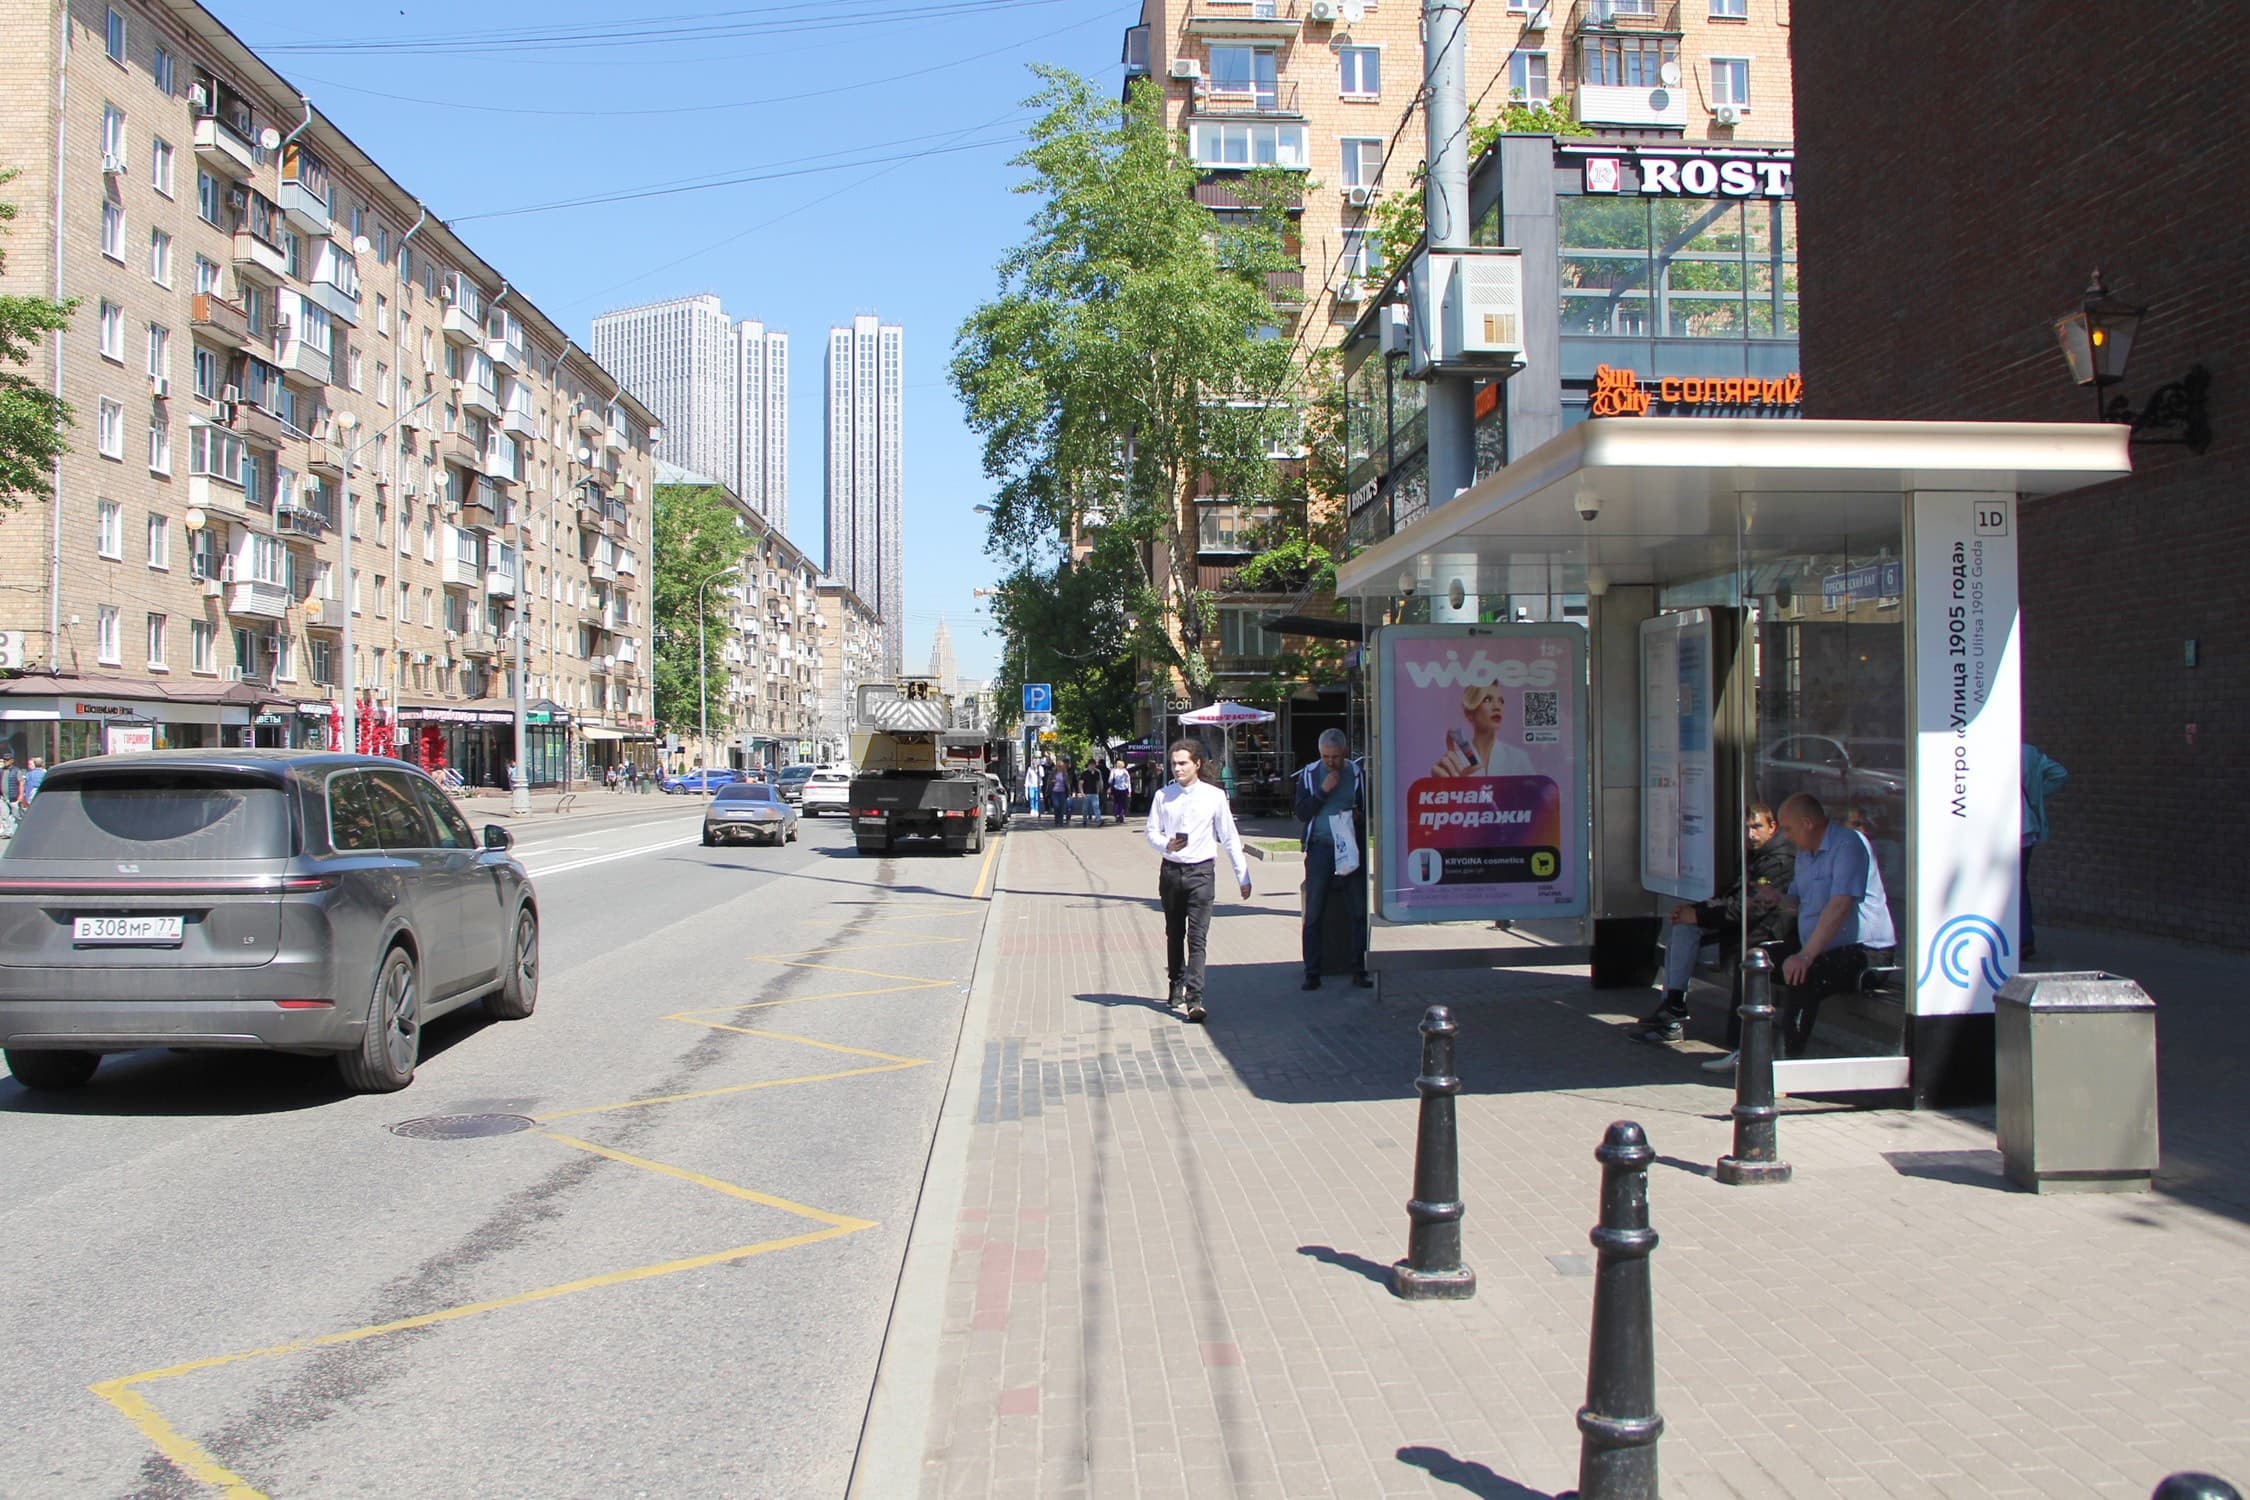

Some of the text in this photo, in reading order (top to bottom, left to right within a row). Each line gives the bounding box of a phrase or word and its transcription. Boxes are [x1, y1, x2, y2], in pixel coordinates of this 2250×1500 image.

[1640, 159, 1792, 196] ROST
[1596, 363, 1635, 390] Sun
[1661, 372, 1802, 404] СОЛЯРИЙ
[1612, 387, 1652, 417] City
[1978, 511, 2003, 528] 1D
[1887, 568, 1894, 585] 6
[1971, 539, 1985, 705] Metro Ulitsa 1905 Goda
[1405, 649, 1558, 689] wibes
[1948, 540, 1971, 819] Метро «Улица 1905 года»
[1418, 785, 1494, 806] качай
[1418, 809, 1532, 831] продажи
[1445, 857, 1525, 865] KRYGINA cosmetics
[81, 918, 176, 936] В308МР 77
[243, 936, 255, 945] L9
